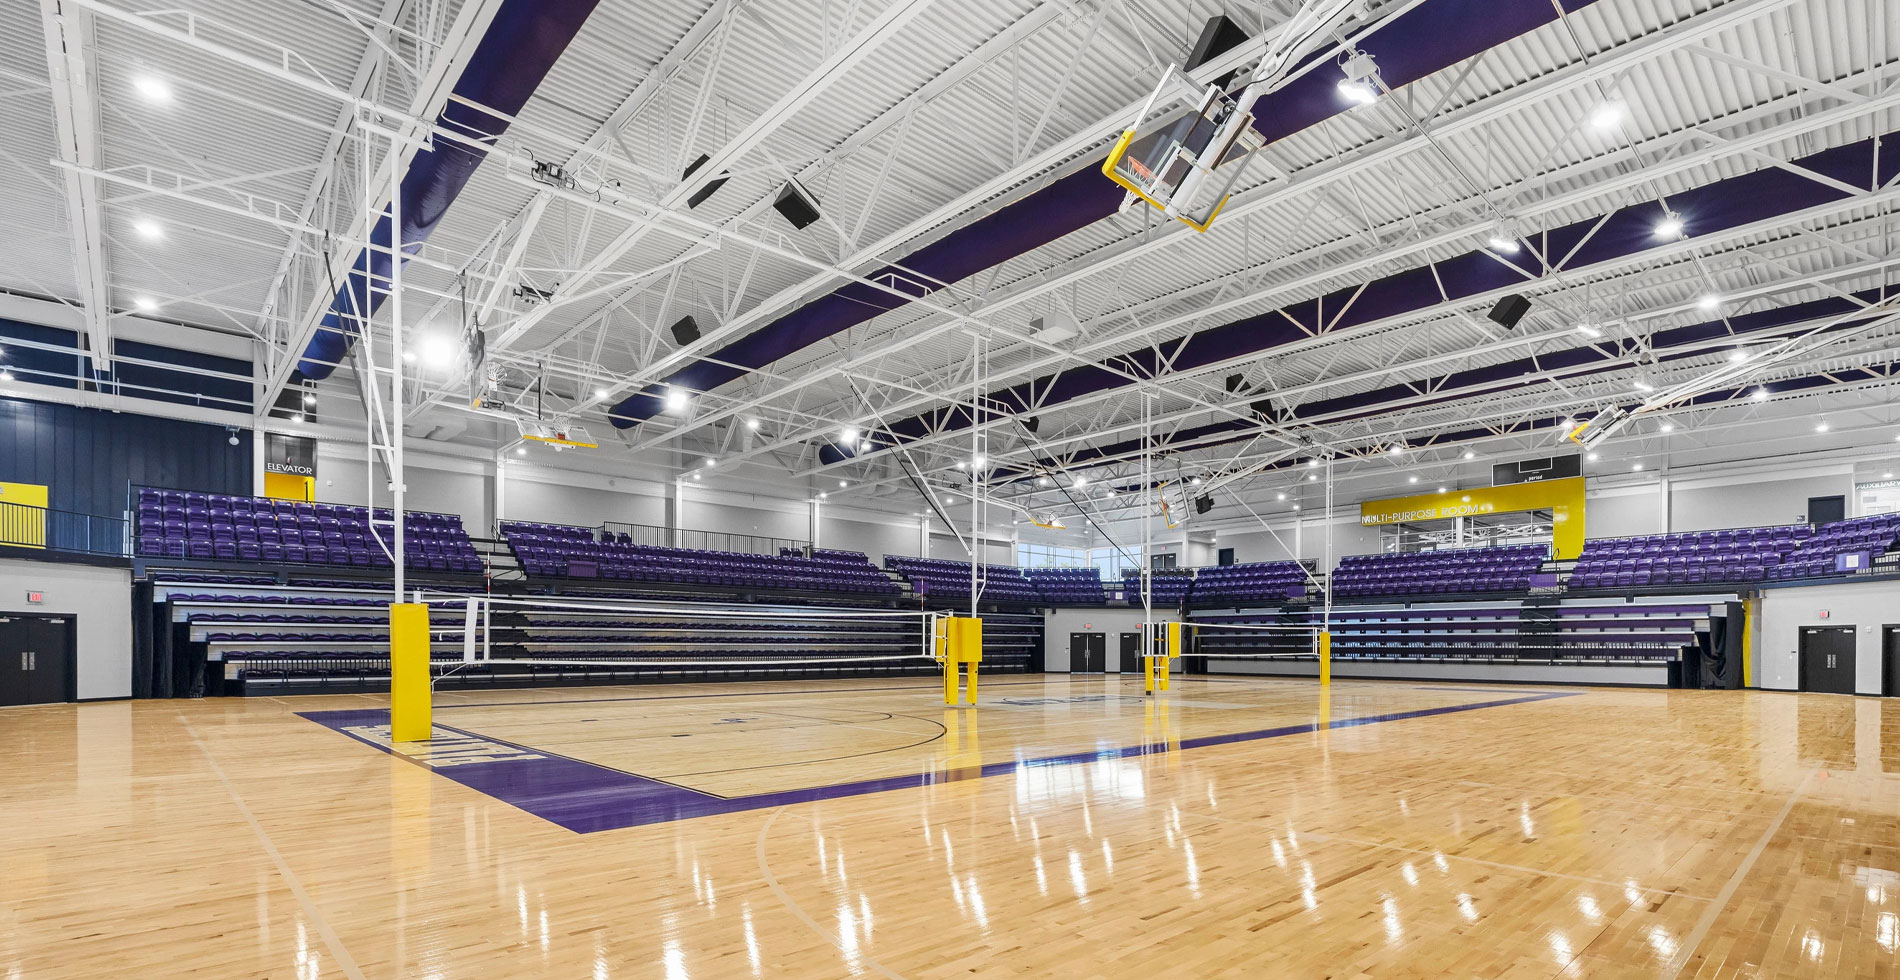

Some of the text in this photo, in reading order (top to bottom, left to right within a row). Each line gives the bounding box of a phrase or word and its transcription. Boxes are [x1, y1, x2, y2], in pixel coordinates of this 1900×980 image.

[267, 463, 312, 474] ELEVATOR
[1361, 505, 1479, 523] MULTI-PURPOSE ROOM
